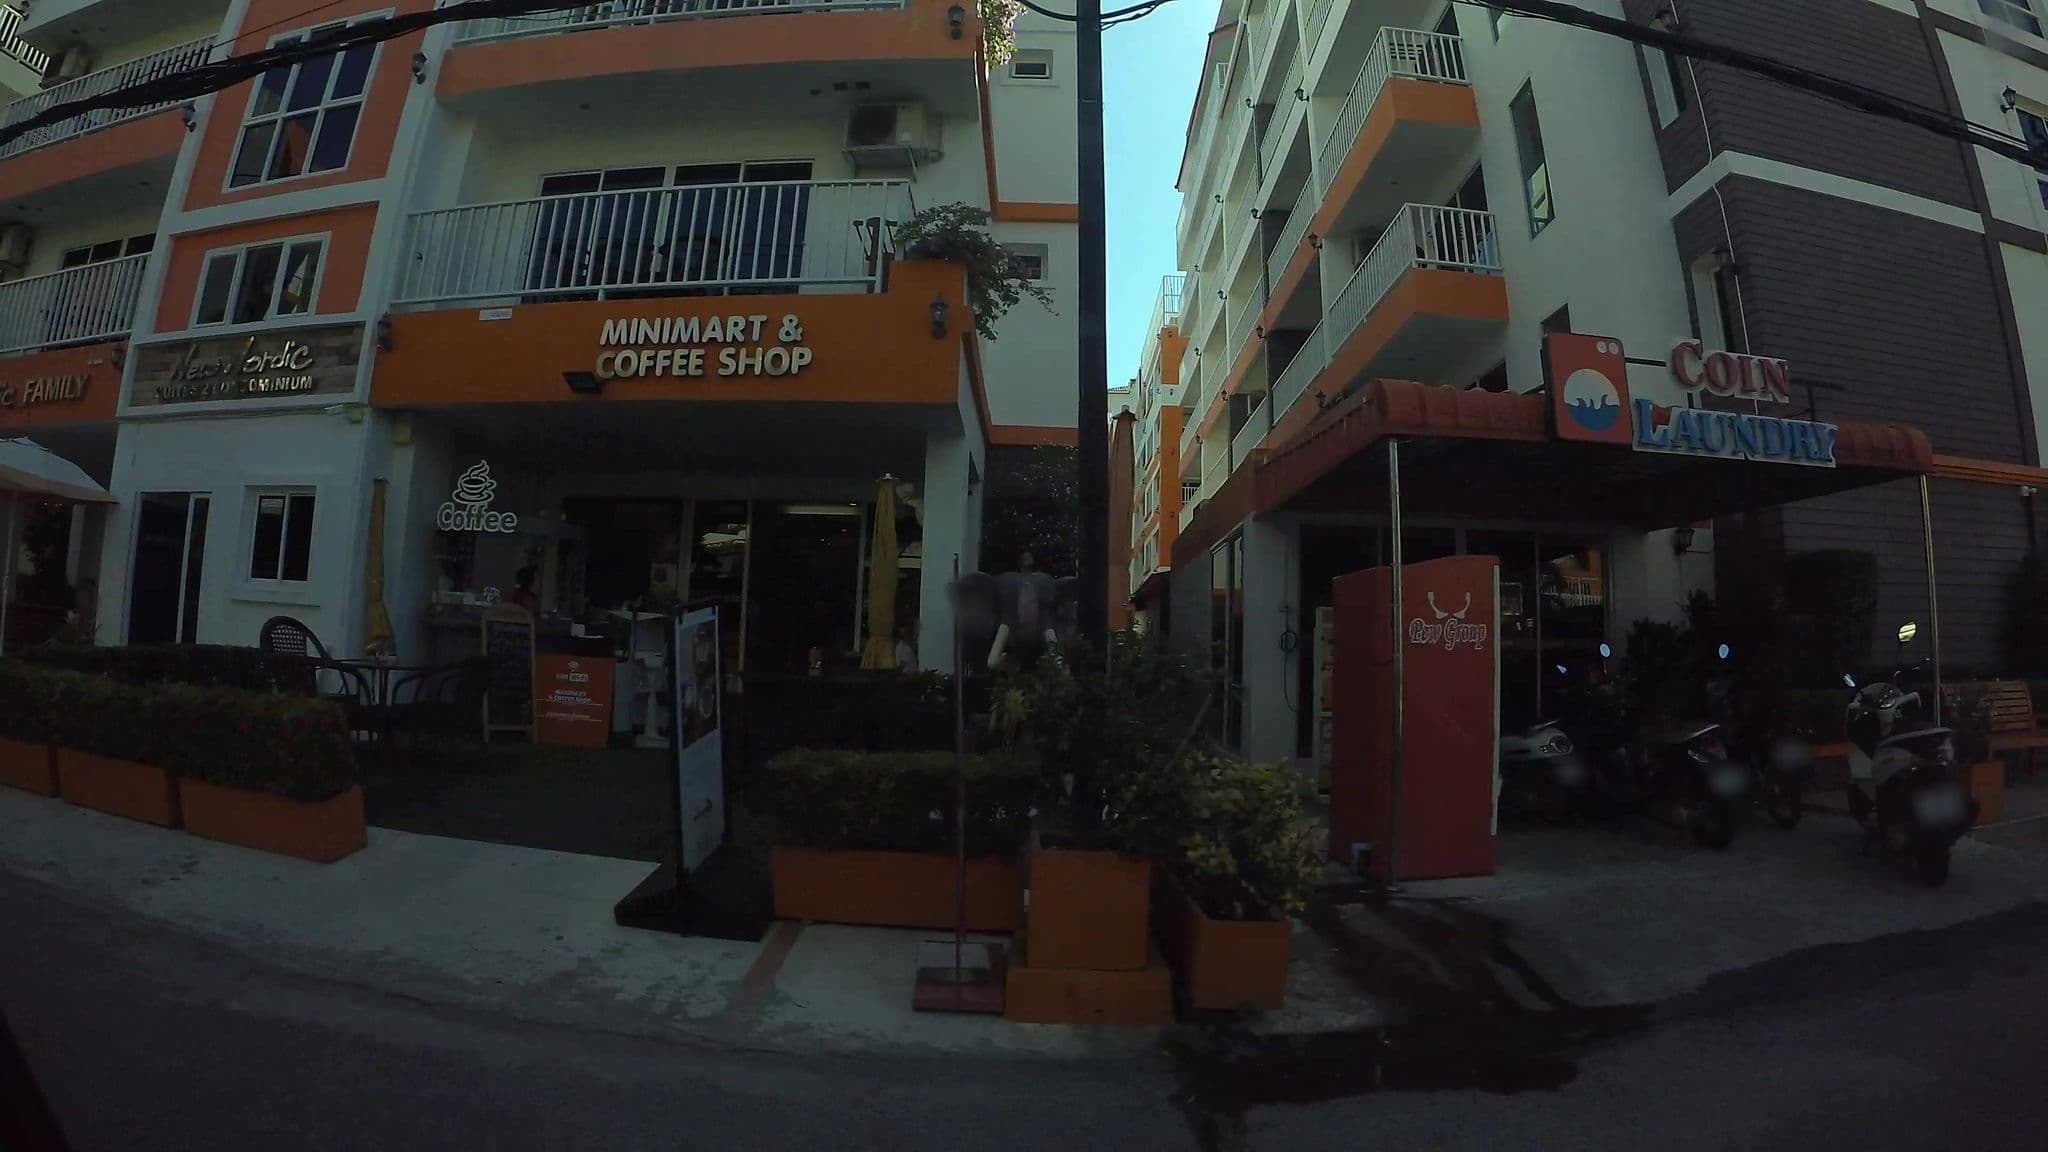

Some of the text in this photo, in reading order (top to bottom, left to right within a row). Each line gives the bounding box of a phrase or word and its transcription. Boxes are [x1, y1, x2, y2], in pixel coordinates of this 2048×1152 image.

[600, 314, 803, 345] MINIMART &
[595, 346, 813, 379] COFFEE SHOP
[1672, 341, 1792, 401] COIN
[23, 374, 89, 403] FAMILY
[1635, 398, 1838, 464] LAUNDRY
[437, 502, 517, 533] Coffee
[1444, 618, 1487, 650] Group
